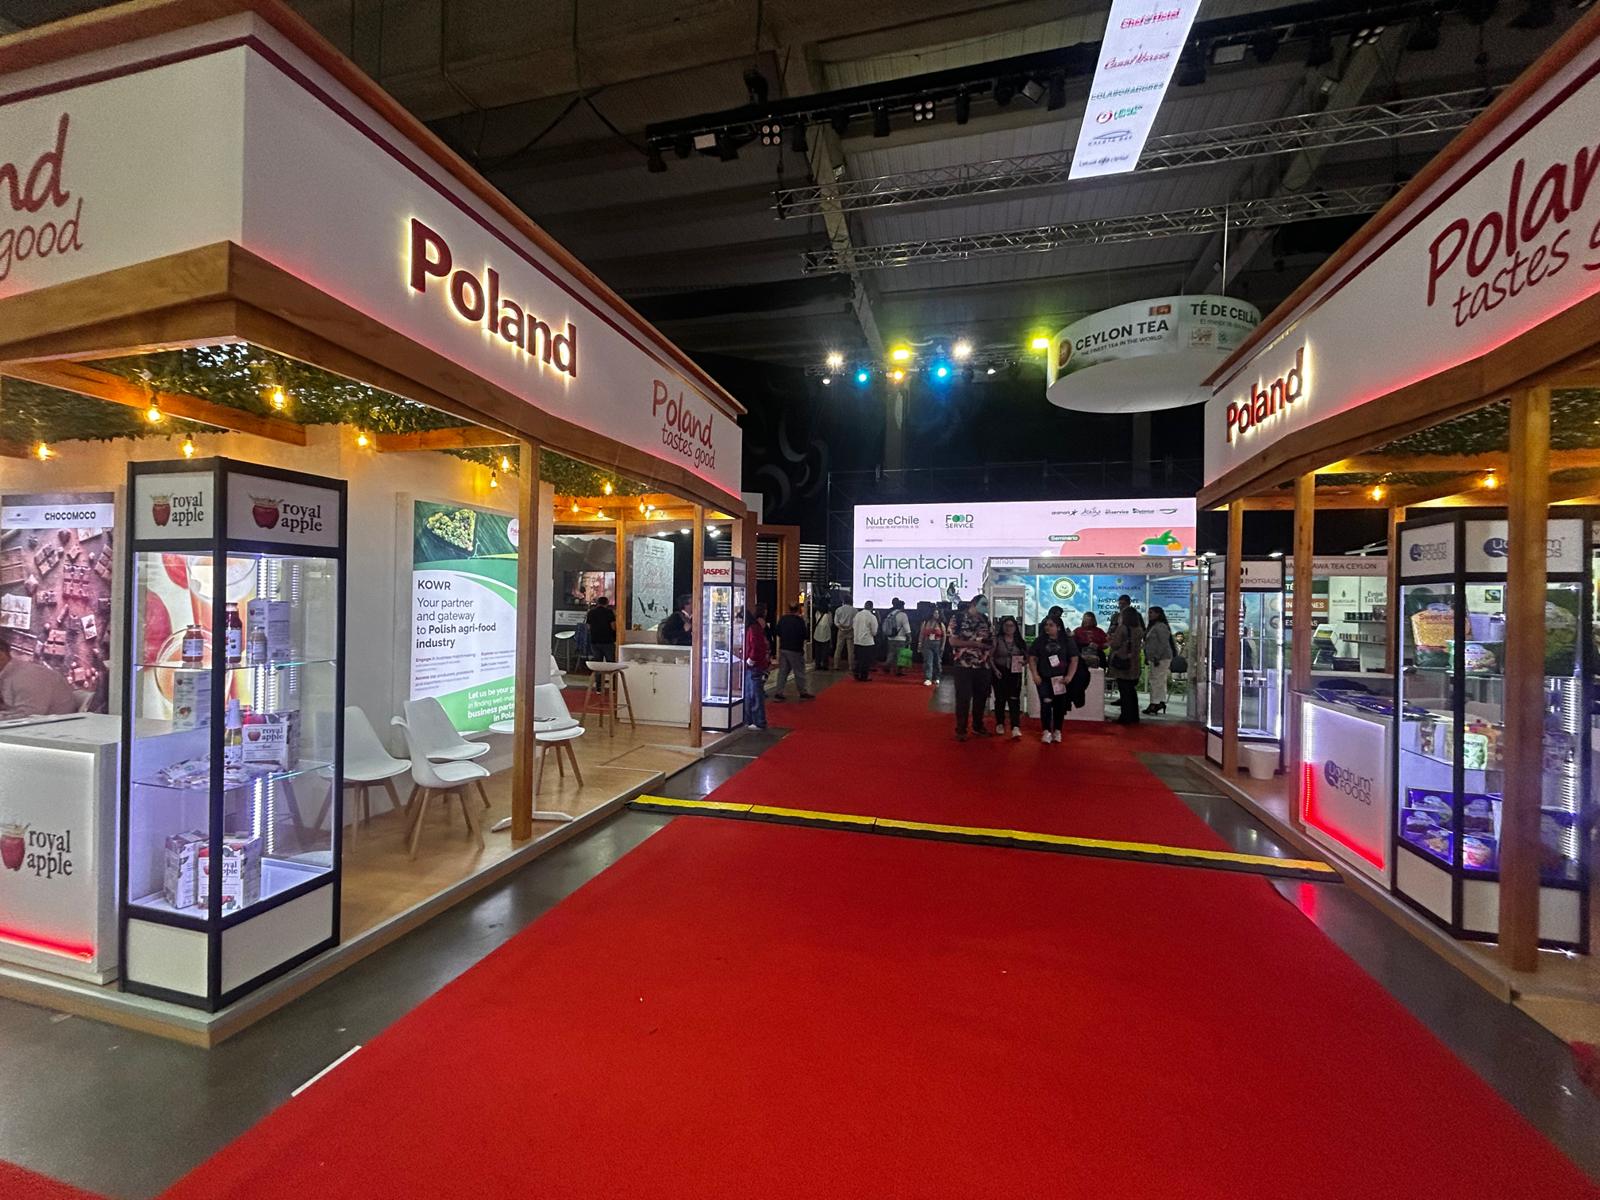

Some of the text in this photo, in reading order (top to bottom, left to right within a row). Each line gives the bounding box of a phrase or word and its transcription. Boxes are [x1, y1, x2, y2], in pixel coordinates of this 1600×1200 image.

[1453, 229, 1571, 328] tastes
[410, 217, 577, 379] Poland
[1190, 300, 1208, 316] TÉ
[1211, 304, 1227, 317] DE
[1075, 319, 1169, 351] CEYLON TEA
[1226, 346, 1304, 442] Poland
[652, 379, 713, 449] Poland
[661, 423, 716, 470] tastes good
[172, 491, 203, 508] royal
[44, 510, 97, 521] CHOCOMOCO
[171, 507, 204, 527] apple
[283, 503, 321, 519] royal
[281, 517, 323, 534] apple
[865, 515, 920, 526] NutreChile
[862, 554, 974, 570] Alimentacion
[417, 580, 451, 591] KOWR
[862, 572, 969, 589] Institucional:
[417, 597, 474, 609] Your partner
[416, 611, 475, 624] and gateway
[416, 622, 496, 635] to Polish agri-food
[416, 638, 456, 649] industry
[468, 690, 480, 700] Let
[487, 686, 496, 696] be
[496, 686, 511, 695] your
[467, 706, 498, 719] business
[261, 733, 284, 742] apple
[262, 726, 283, 735] royal
[1340, 779, 1371, 806] FOODS
[28, 829, 71, 854] royal
[26, 853, 73, 879] apple
